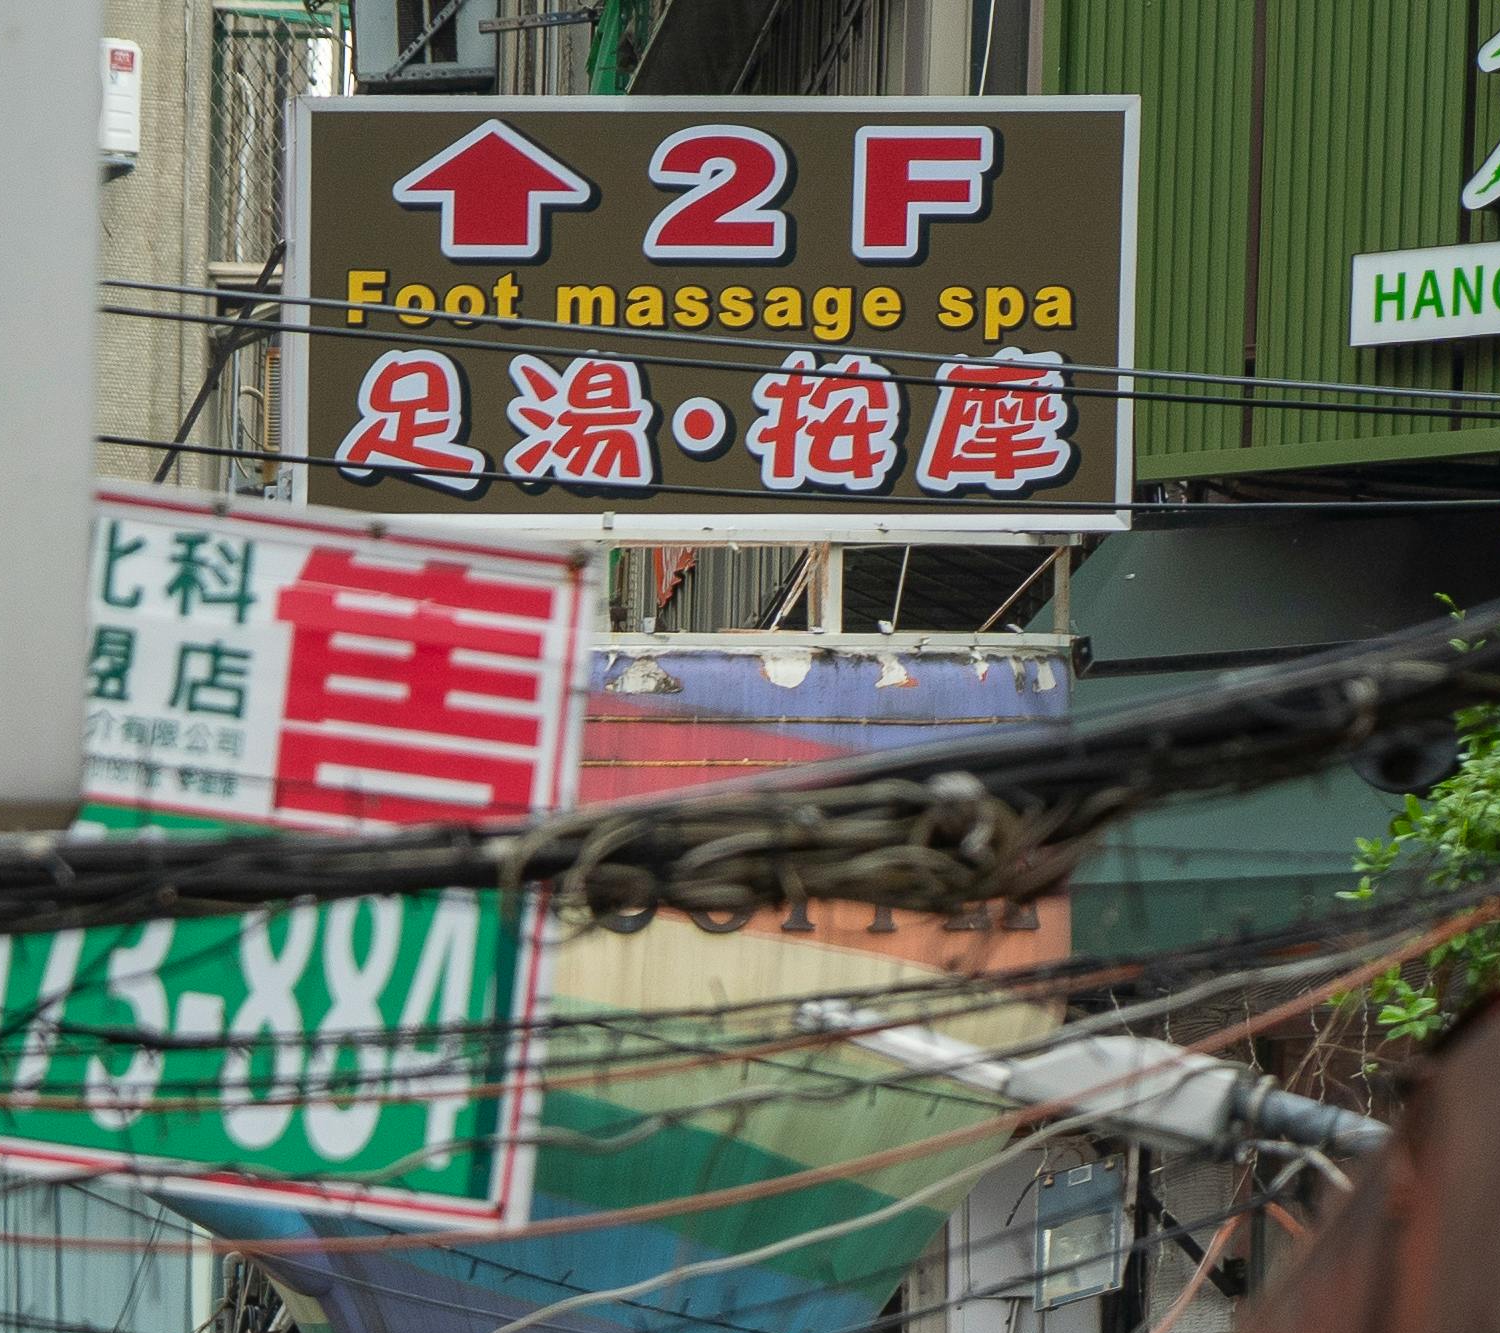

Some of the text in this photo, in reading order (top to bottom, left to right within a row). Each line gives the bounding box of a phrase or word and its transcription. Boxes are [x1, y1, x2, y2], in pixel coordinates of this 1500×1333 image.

[346, 270, 1076, 341] Foot massage spa
